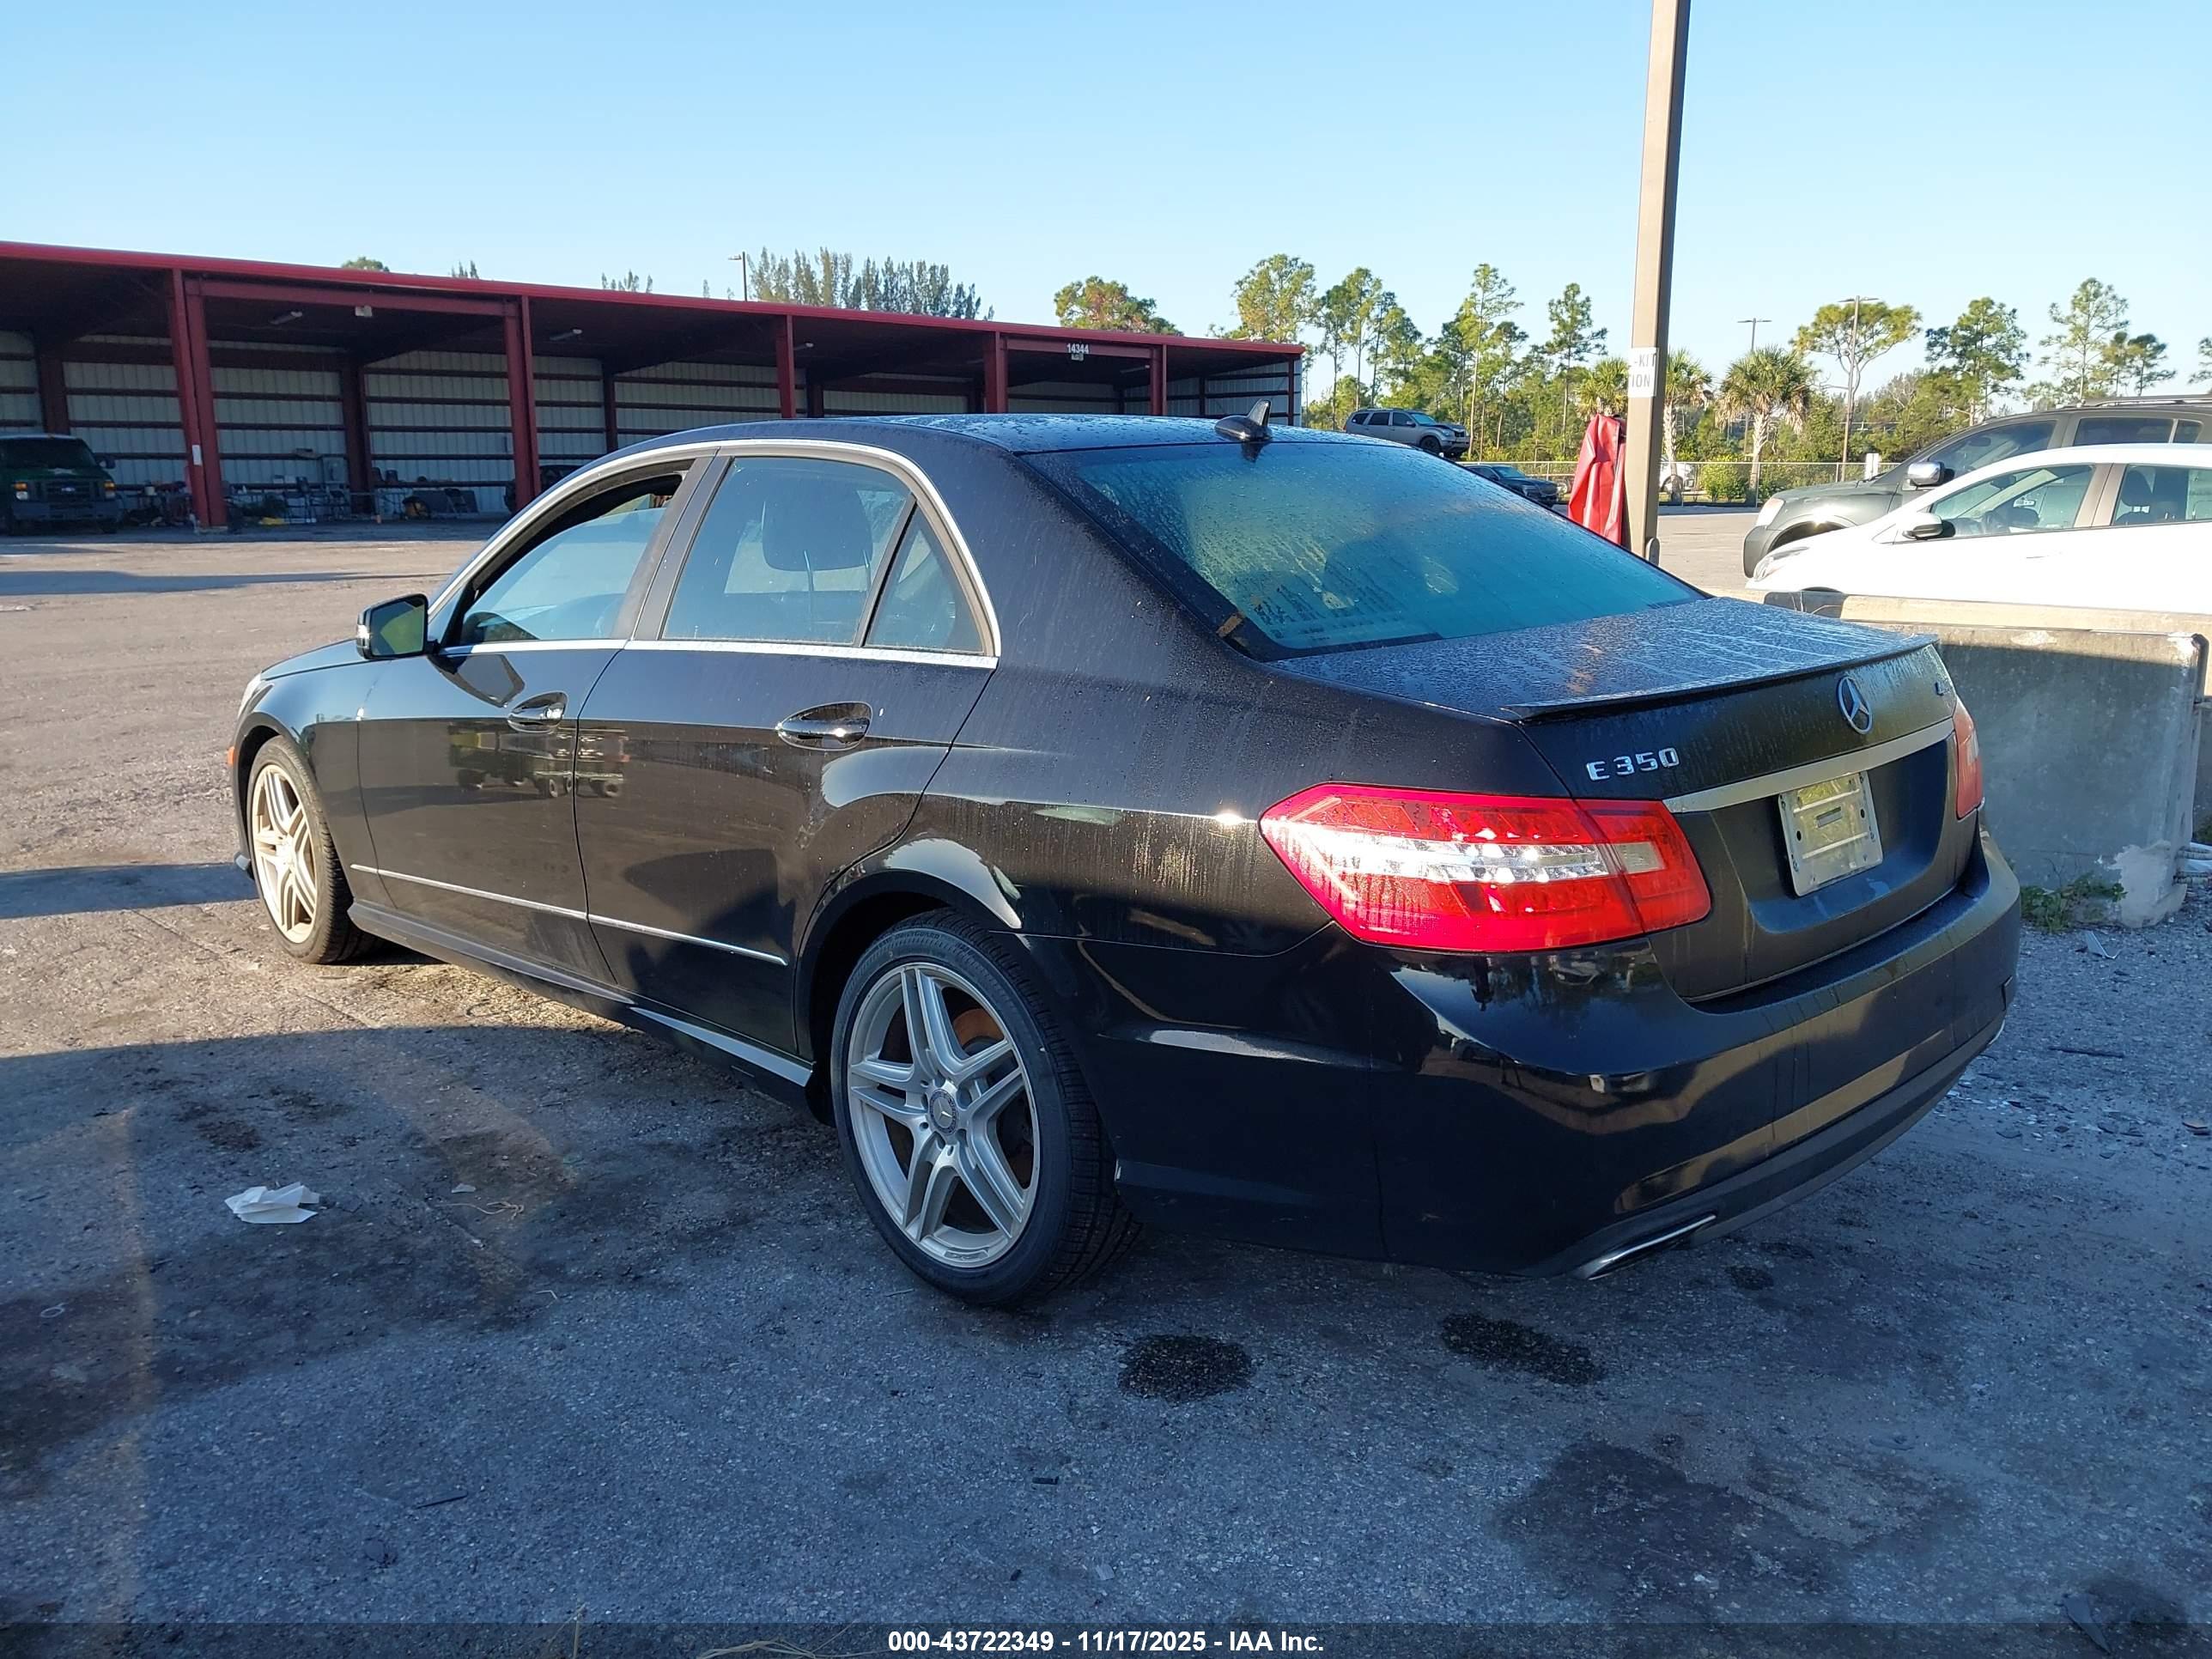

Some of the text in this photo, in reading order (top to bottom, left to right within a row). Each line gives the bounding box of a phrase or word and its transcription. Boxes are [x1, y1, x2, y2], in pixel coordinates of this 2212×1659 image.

[1066, 343, 1089, 354] 14344
[1628, 374, 1650, 387] ION
[1586, 747, 1680, 781] E 350
